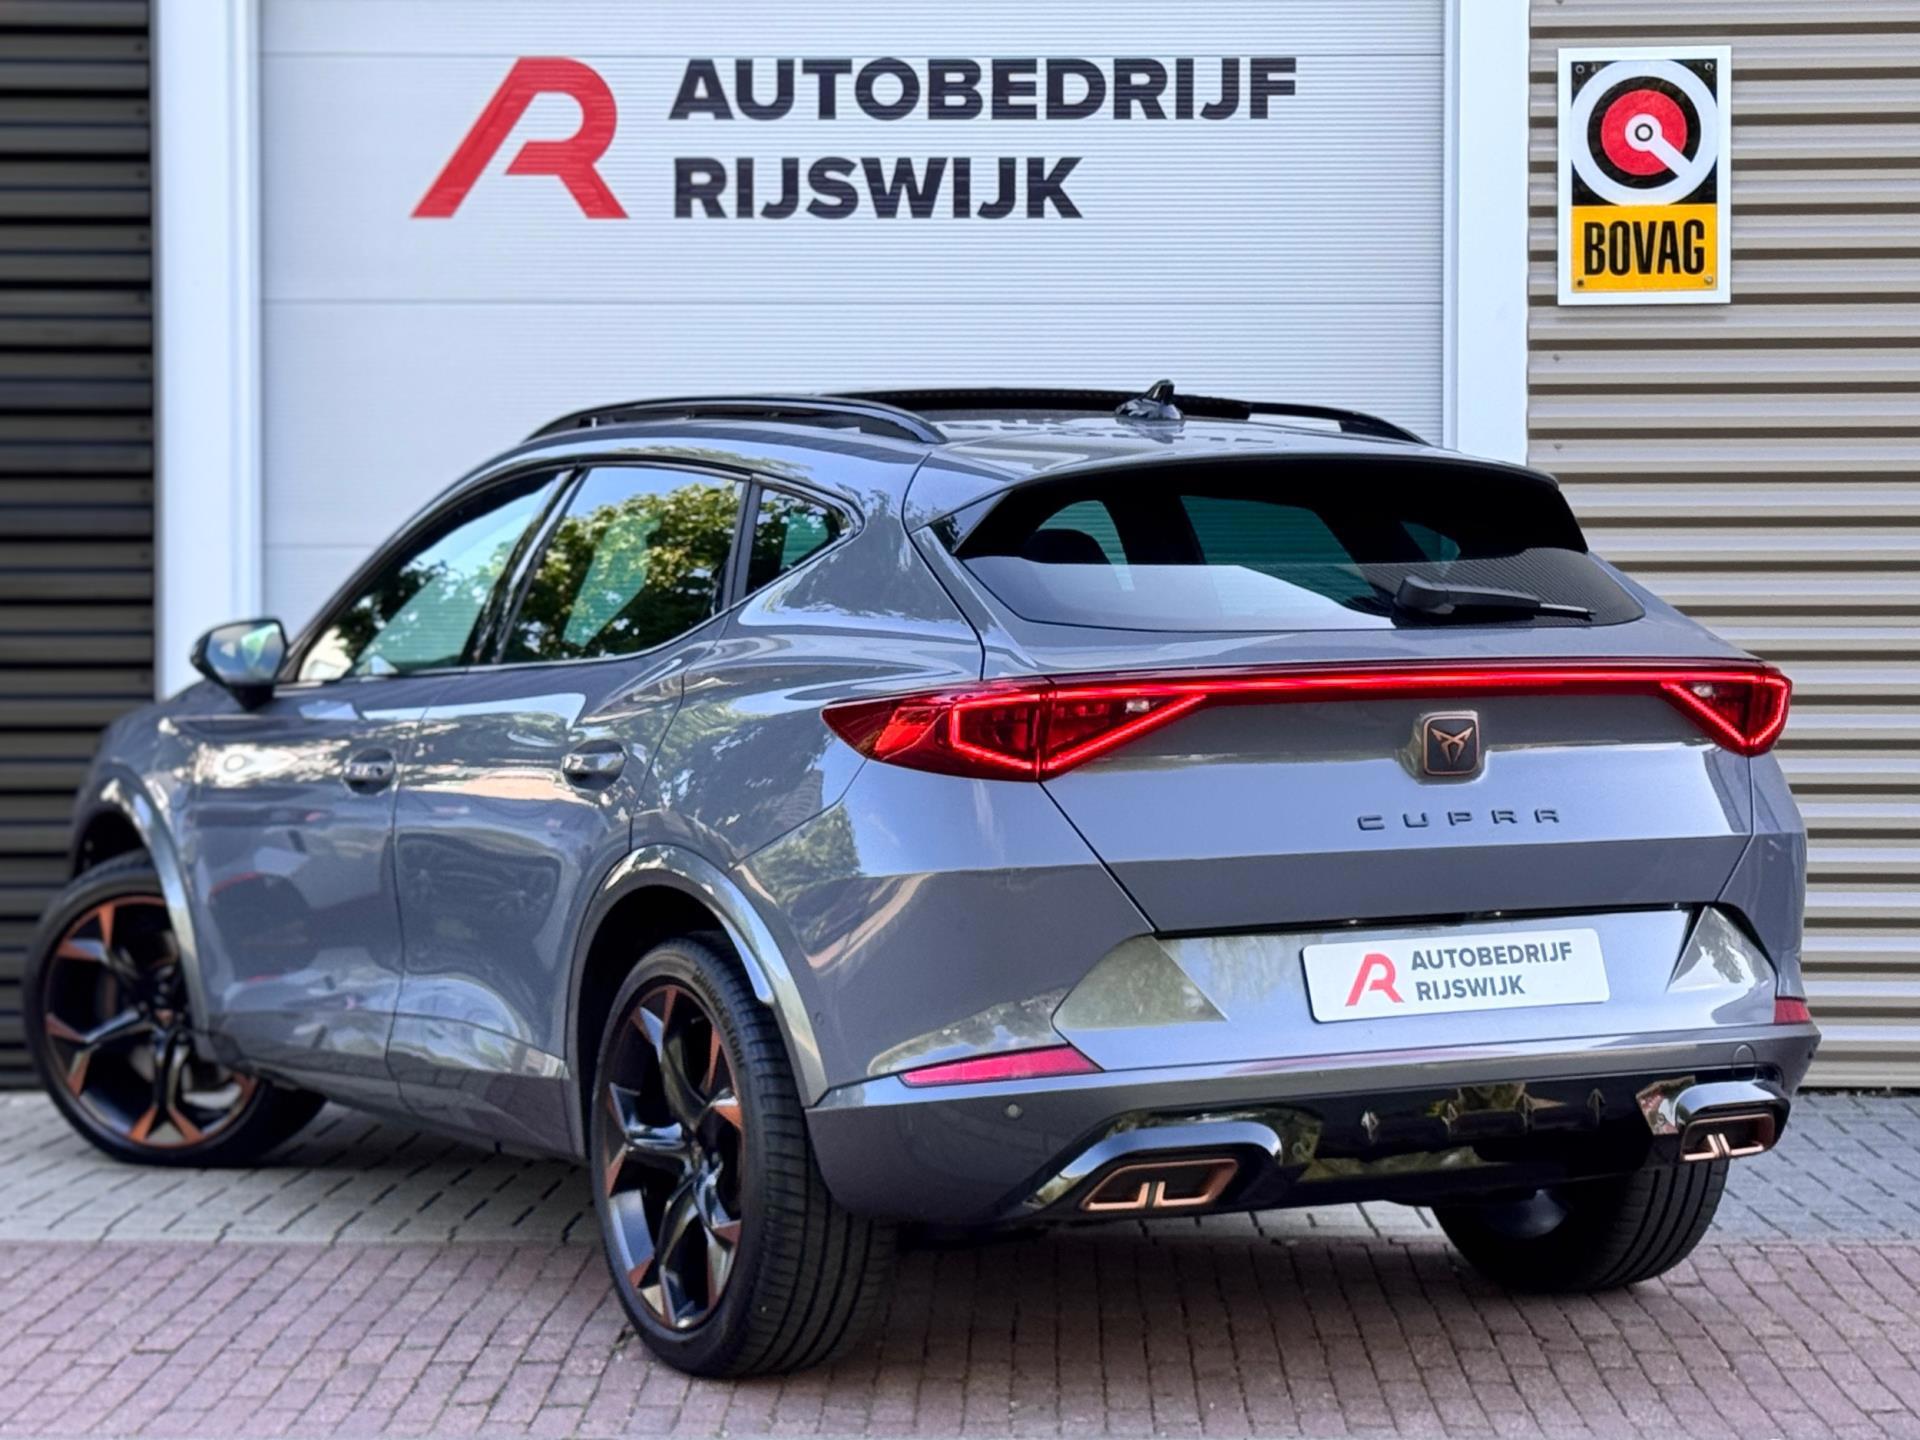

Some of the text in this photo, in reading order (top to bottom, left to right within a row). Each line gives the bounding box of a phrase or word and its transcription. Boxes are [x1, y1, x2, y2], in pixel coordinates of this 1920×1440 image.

[668, 57, 1297, 121] AUTOBEDRIJF
[674, 156, 1084, 219] RIJSWIJK
[1583, 219, 1705, 276] BOVAG
[1357, 809, 1560, 831] CUPRA
[1411, 941, 1573, 971] AUTOBEDRIJF
[1415, 974, 1526, 1001] RIJSWIJK
